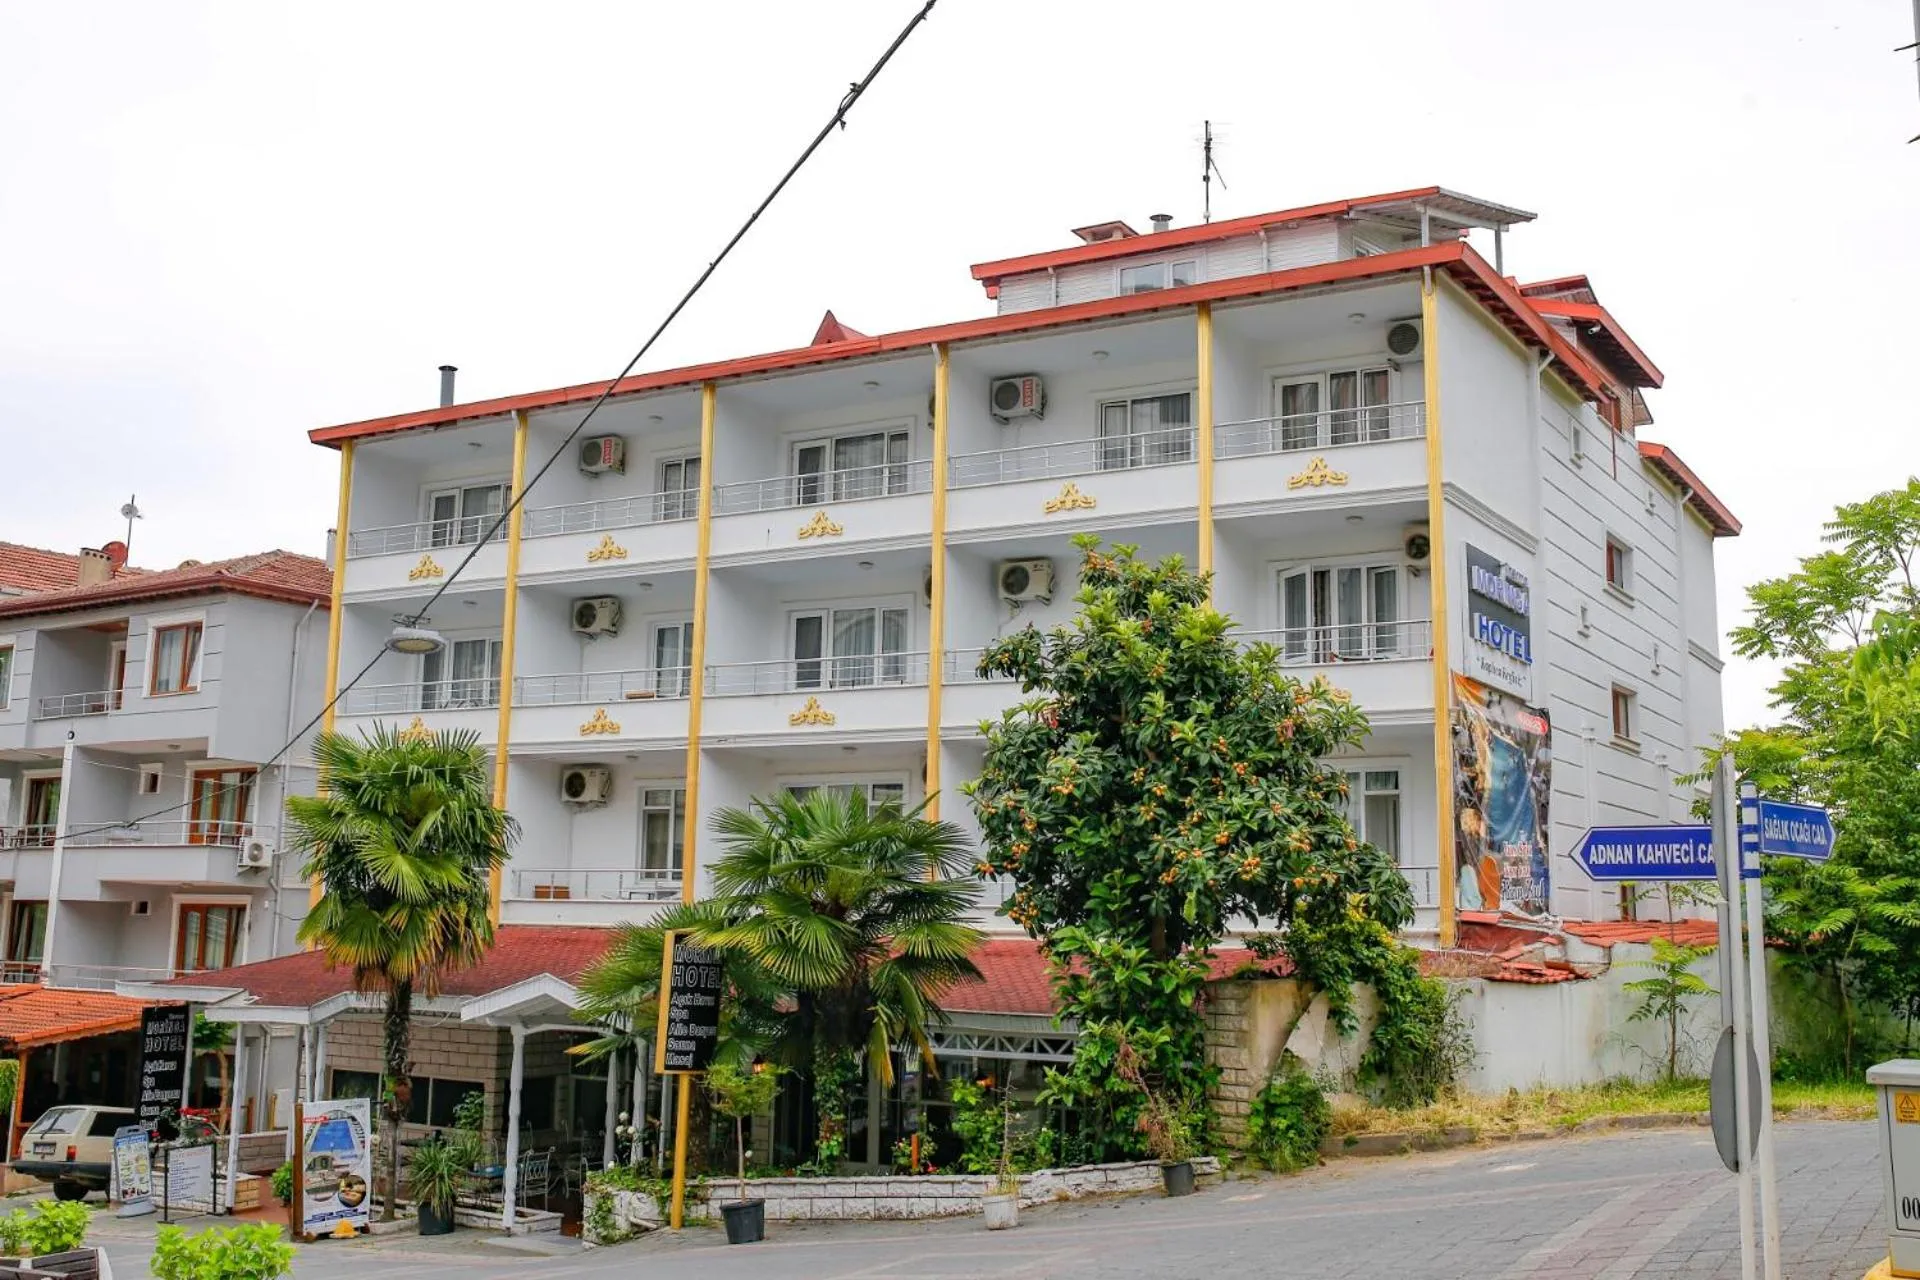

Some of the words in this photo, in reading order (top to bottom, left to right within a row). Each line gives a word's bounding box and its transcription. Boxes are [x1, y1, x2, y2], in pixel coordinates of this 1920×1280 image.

[1474, 613, 1532, 664] HOTEL
[1764, 814, 1790, 841] SAĞLIK
[1790, 818, 1811, 844] OCAĞI
[1589, 843, 1632, 865] ADNAN
[1637, 838, 1694, 865] KAHVECİ
[1698, 843, 1714, 864] CA
[671, 965, 721, 988] HOTEL
[670, 1006, 689, 1021] Spa
[144, 1035, 184, 1052] HOTEL
[667, 1038, 696, 1051] Sauna
[665, 1053, 693, 1068] Masaj
